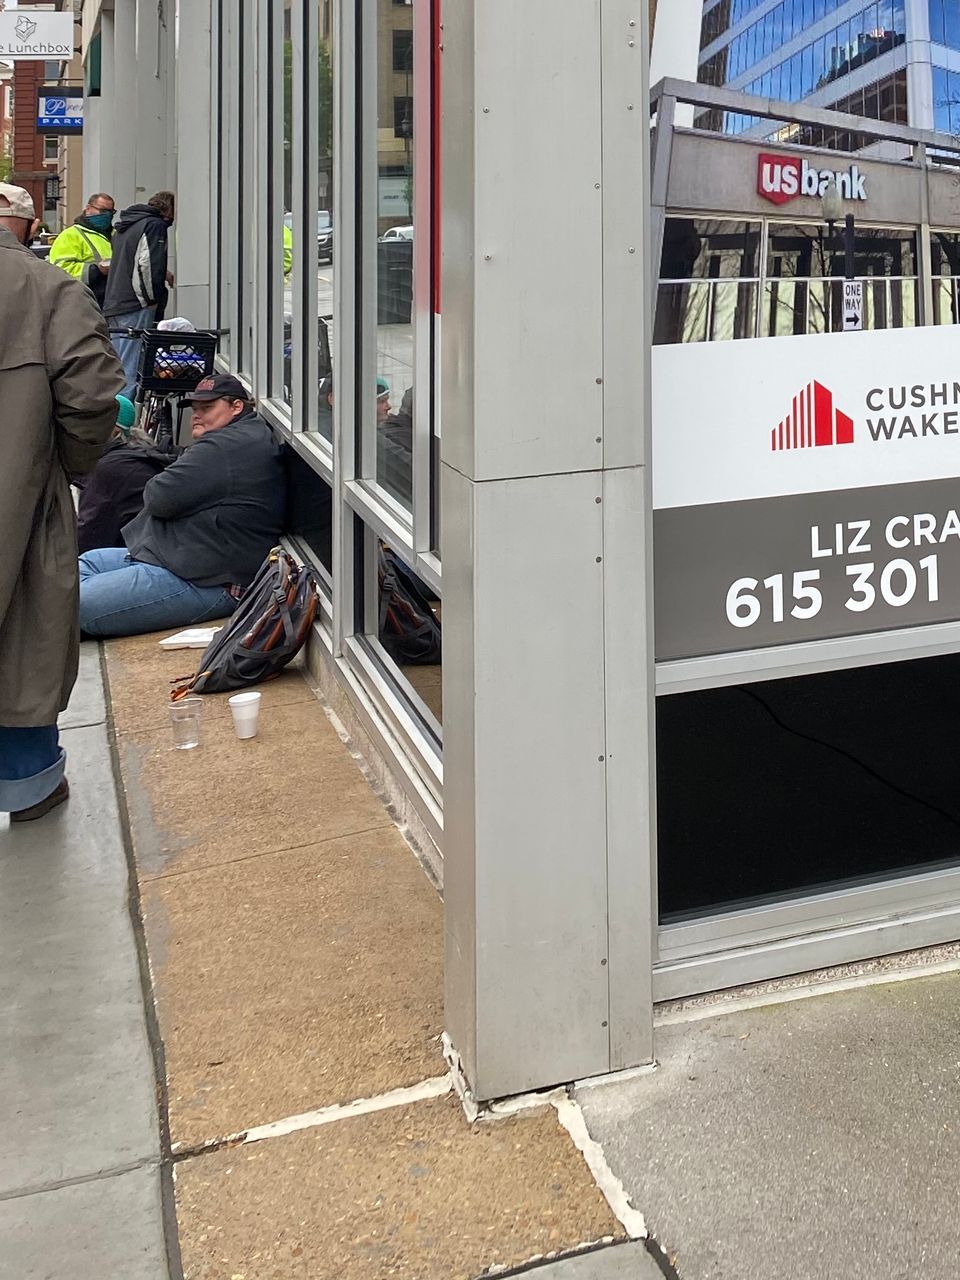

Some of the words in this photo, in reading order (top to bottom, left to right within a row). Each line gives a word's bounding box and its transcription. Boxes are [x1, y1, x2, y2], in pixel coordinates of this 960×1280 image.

[8, 42, 70, 53] Lunchbox
[845, 284, 861, 297] ONE
[845, 298, 862, 312] WAY
[810, 519, 872, 558] LIZ
[725, 568, 823, 628] 615
[844, 553, 939, 613] 301
